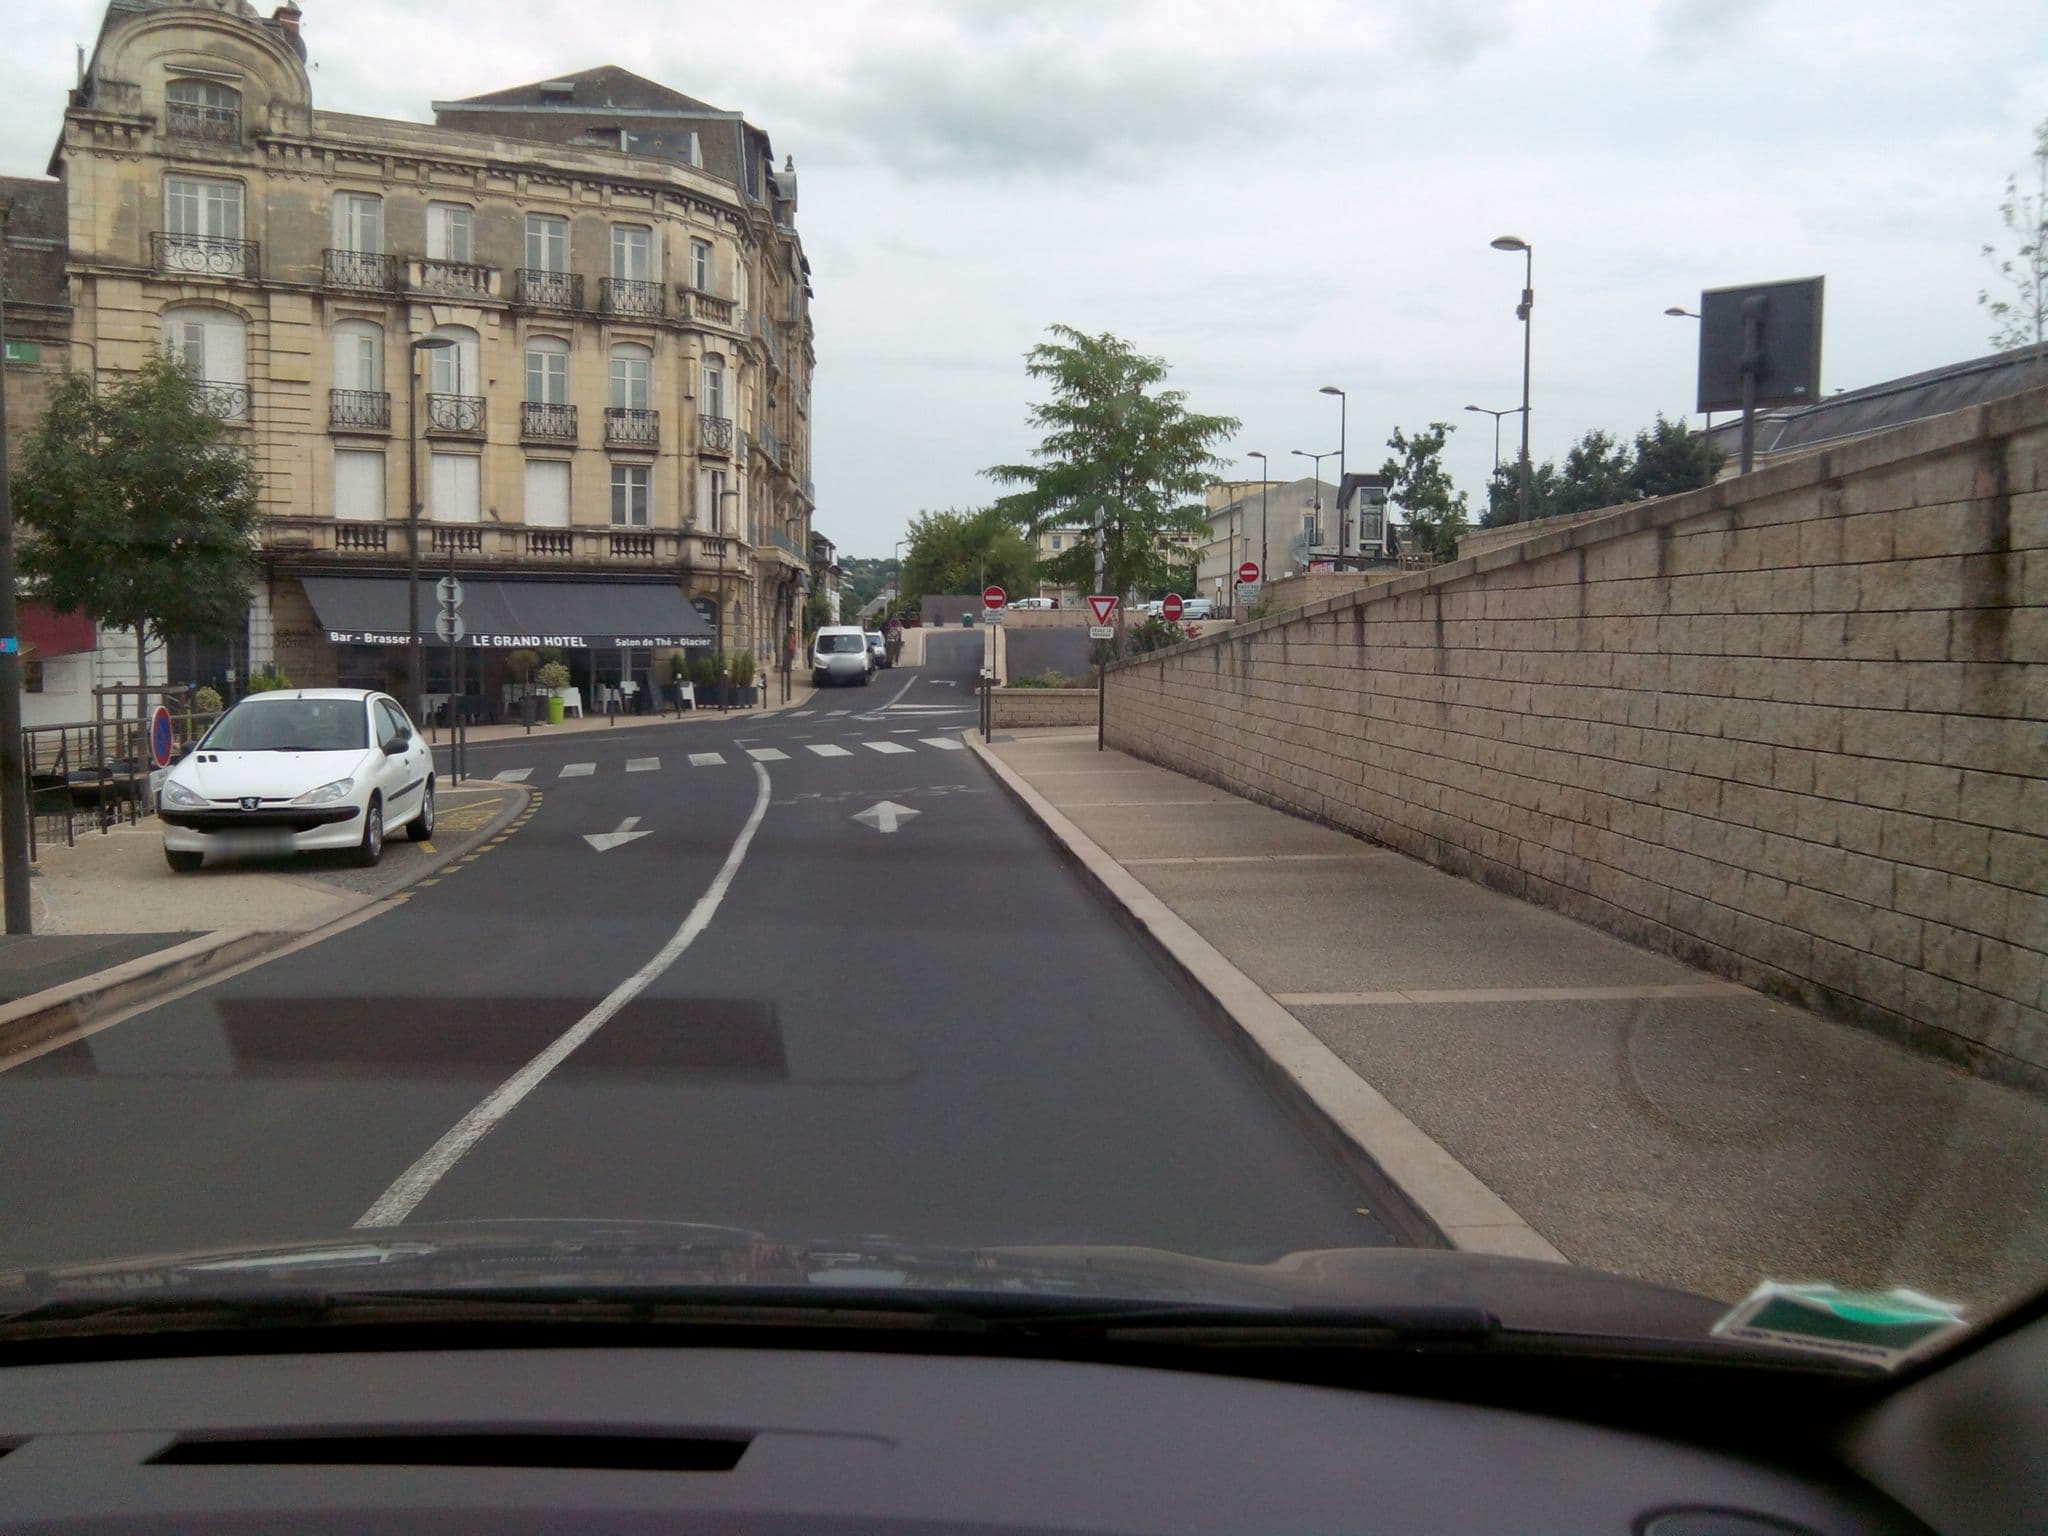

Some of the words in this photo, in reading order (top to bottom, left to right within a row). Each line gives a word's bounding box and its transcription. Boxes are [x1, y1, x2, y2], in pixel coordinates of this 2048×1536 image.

[330, 631, 352, 642] Bar
[473, 635, 490, 647] LE
[493, 635, 540, 647] GRAND
[544, 636, 588, 647] HOTEL
[615, 638, 641, 647] Salon
[642, 638, 654, 646] de
[655, 637, 672, 646] Thé
[680, 638, 711, 646] Glacier
